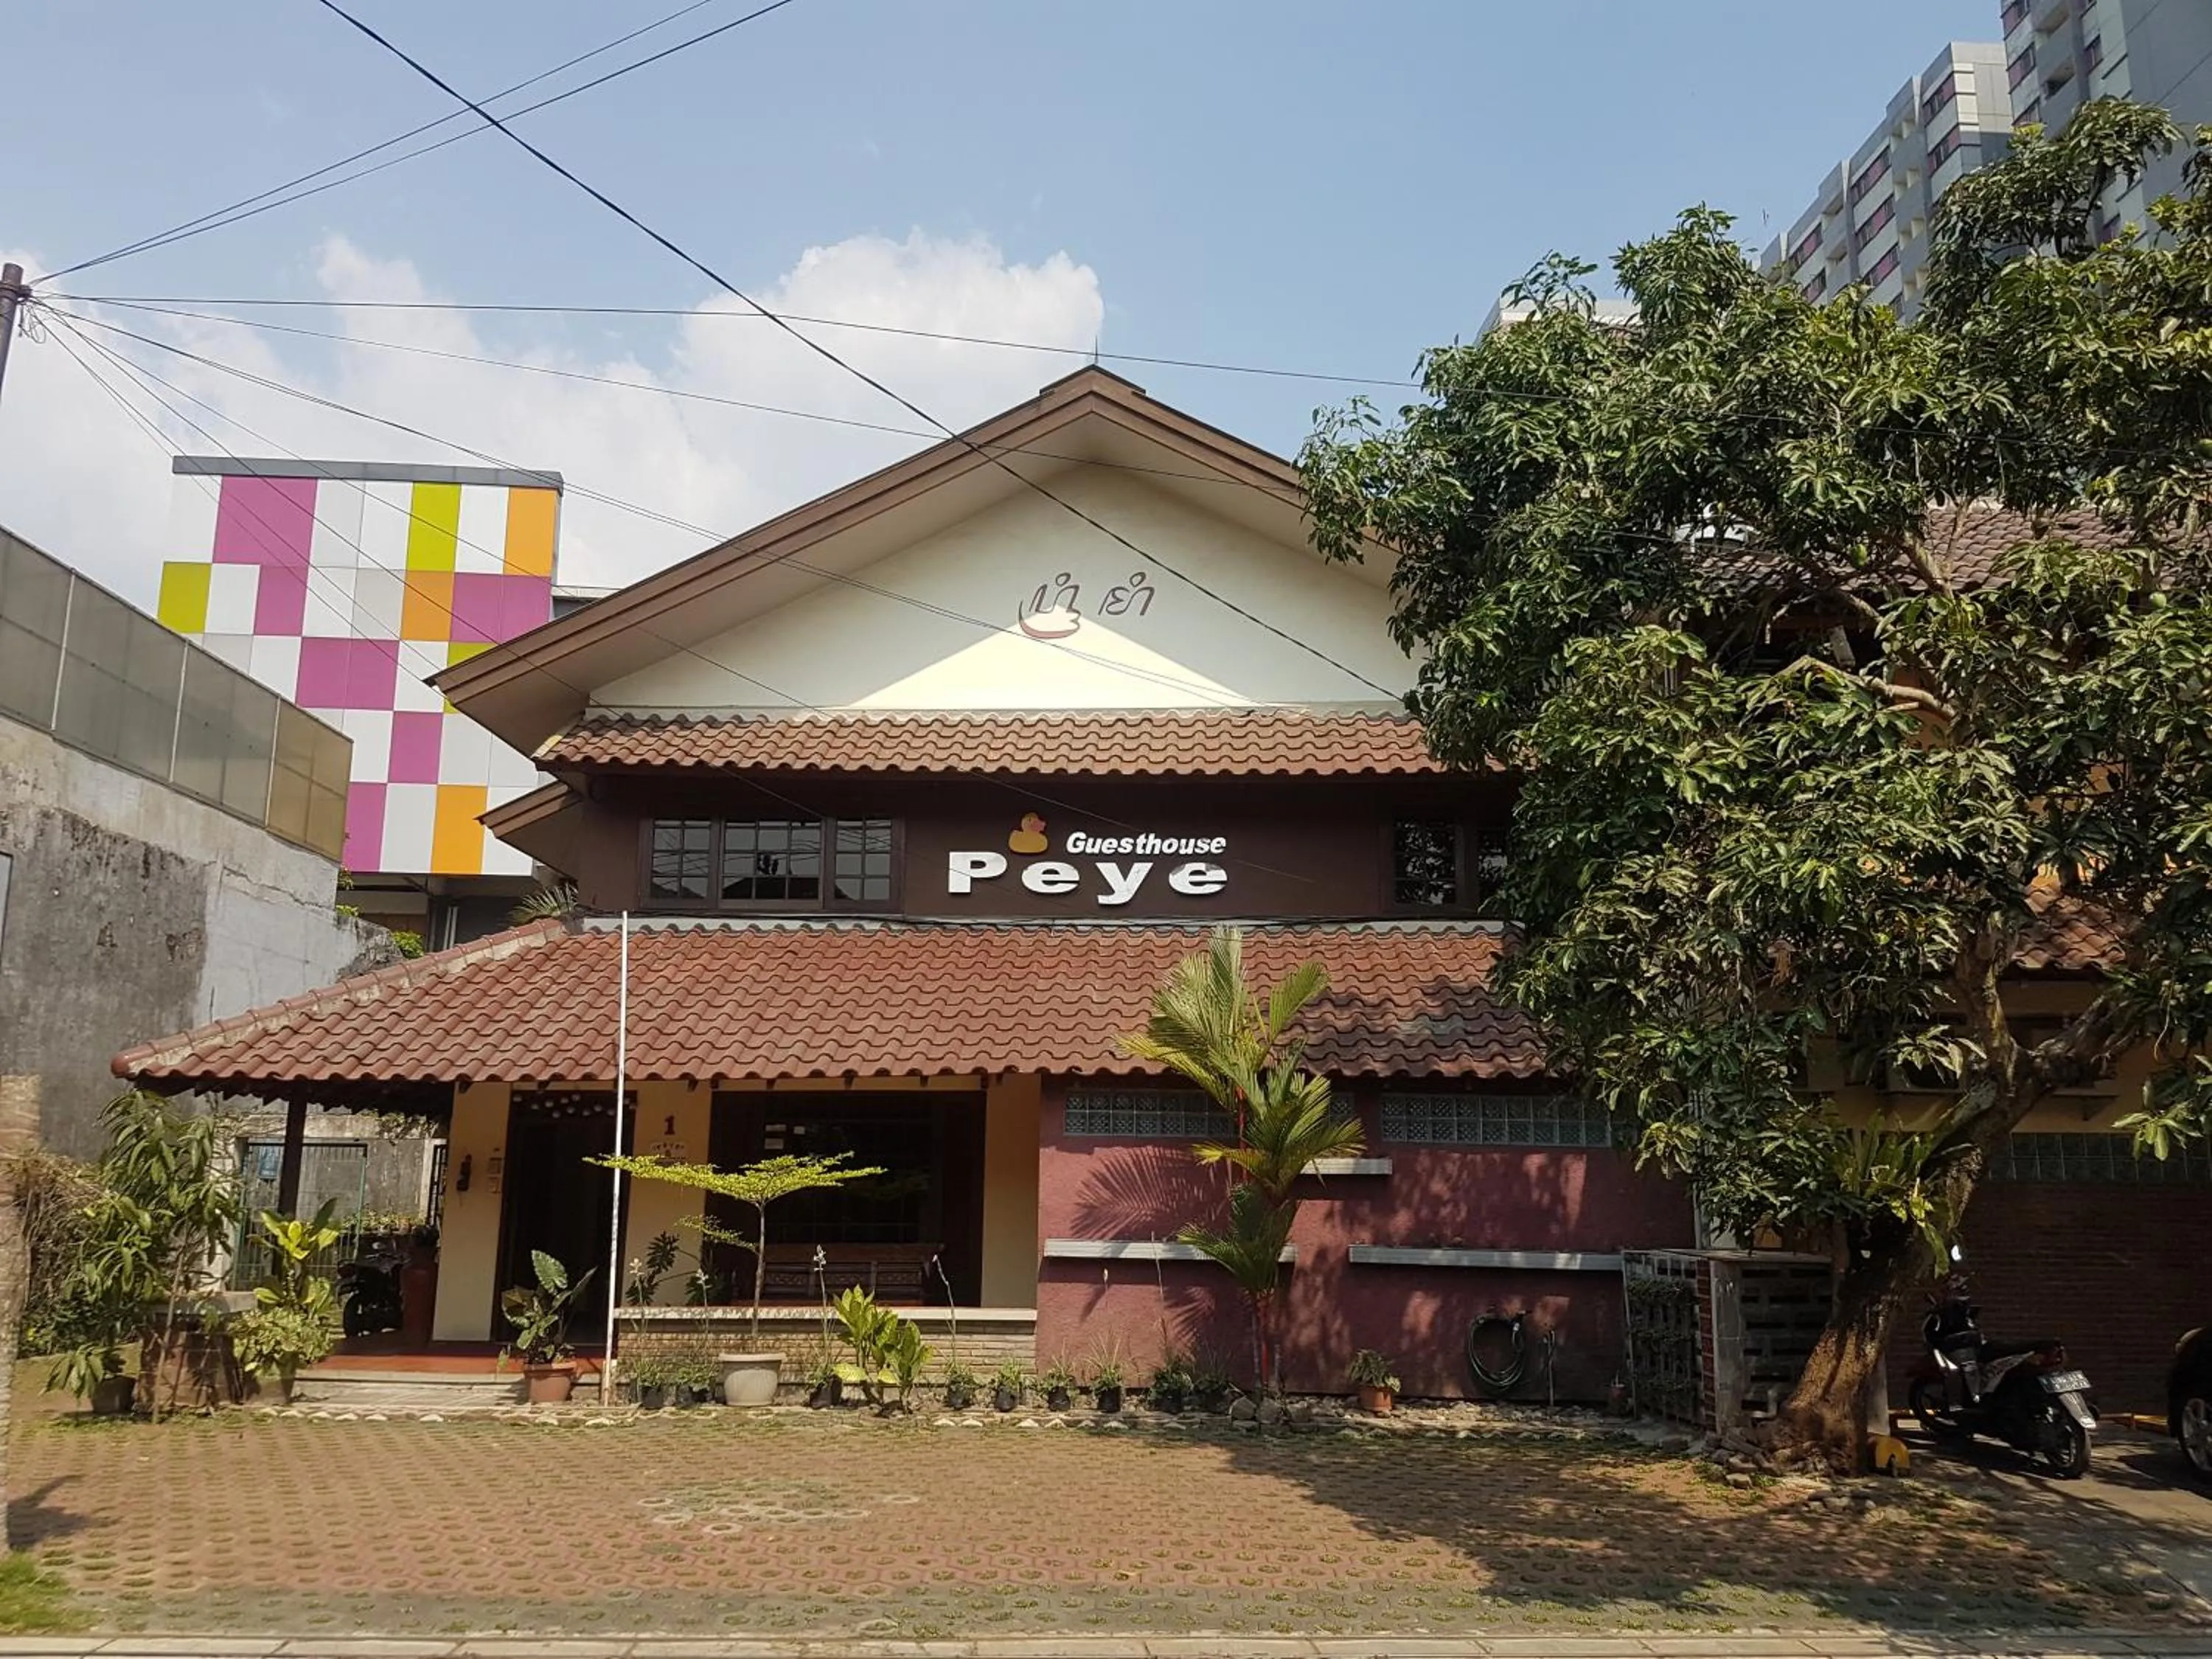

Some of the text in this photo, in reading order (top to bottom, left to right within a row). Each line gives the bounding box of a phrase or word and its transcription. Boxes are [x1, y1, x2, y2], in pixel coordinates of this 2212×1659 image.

[1066, 831, 1227, 855] Guesthouse
[948, 852, 1228, 905] Peye
[664, 1115, 675, 1135] 1
